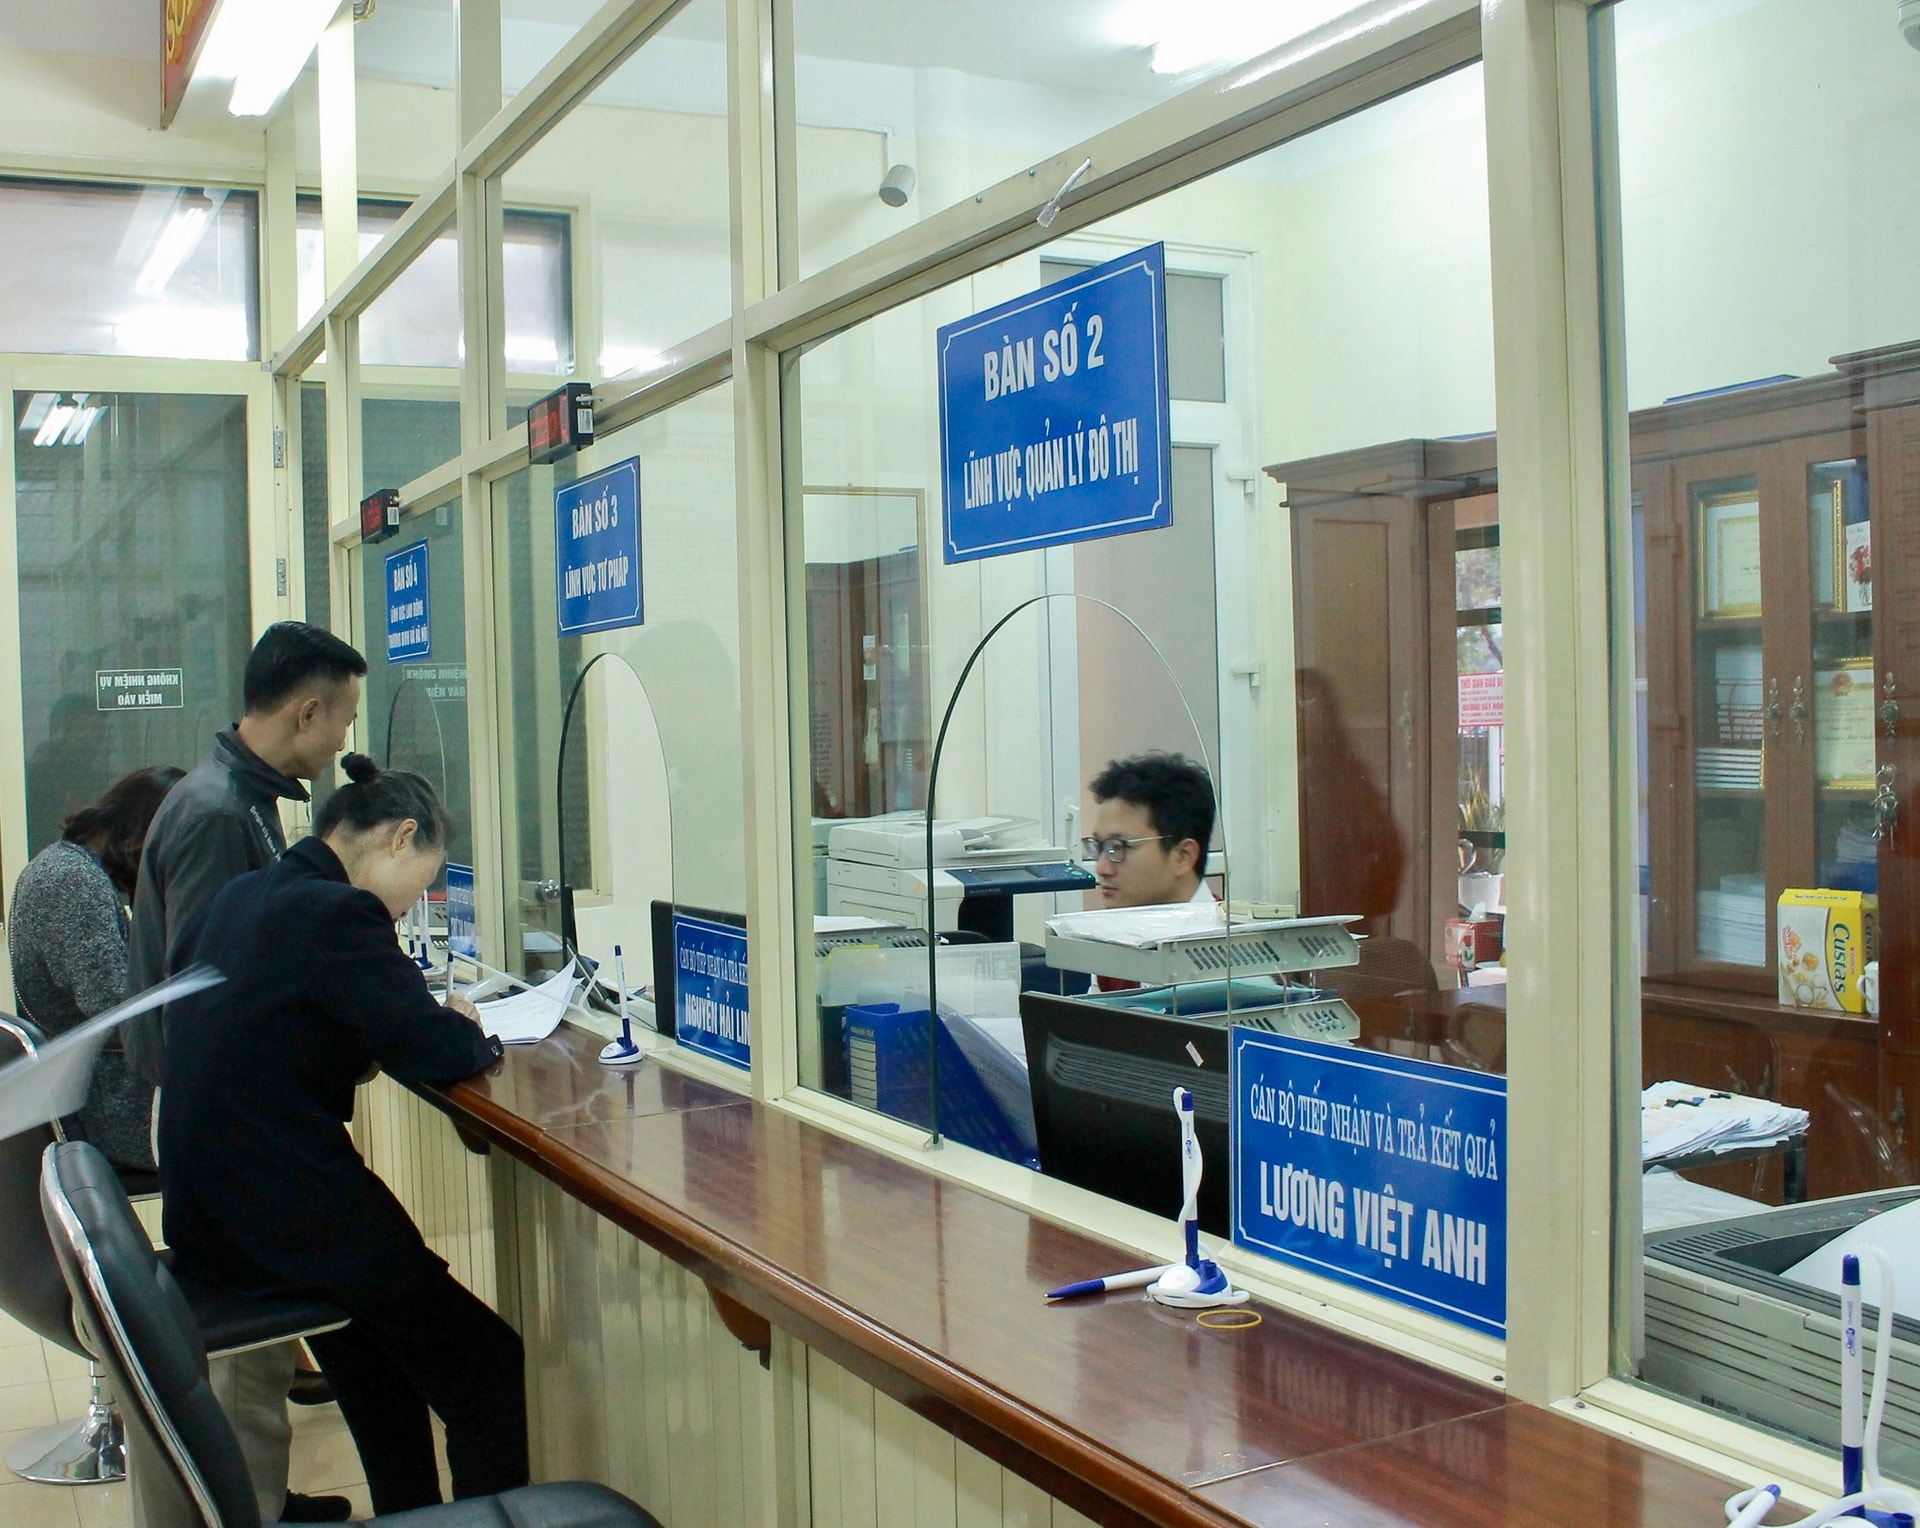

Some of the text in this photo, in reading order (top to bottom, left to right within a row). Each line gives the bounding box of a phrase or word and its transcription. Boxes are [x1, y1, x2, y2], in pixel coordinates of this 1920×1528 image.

[984, 302, 1104, 401] BÀN SỐ 2
[964, 414, 1139, 512] LĨNH VỰC QUẢN LÝ ĐÔ THỊ
[572, 485, 618, 540] BÀN SỐ 3
[393, 563, 405, 593] BÀN
[405, 555, 413, 589] SỐ
[565, 550, 629, 601] LĨNH VỰC TƯ PHÁP
[407, 667, 436, 680] KHÔNG
[680, 941, 690, 969] CÁN
[690, 943, 696, 977] BỘ
[696, 941, 706, 974] TIẾP
[707, 950, 721, 983] NHẬN
[721, 952, 728, 981] VÀ
[728, 951, 738, 983] TRẢ
[1833, 921, 1850, 994] Custas
[685, 986, 718, 1035] NGUYỄN
[719, 990, 734, 1041] HẢI
[1250, 1073, 1498, 1181] CÁN BỘ TIẾP NHẬN VÀ TRẢ KẾT QUẢ
[1260, 1161, 1487, 1286] LƯƠNG VIỆT ANH
